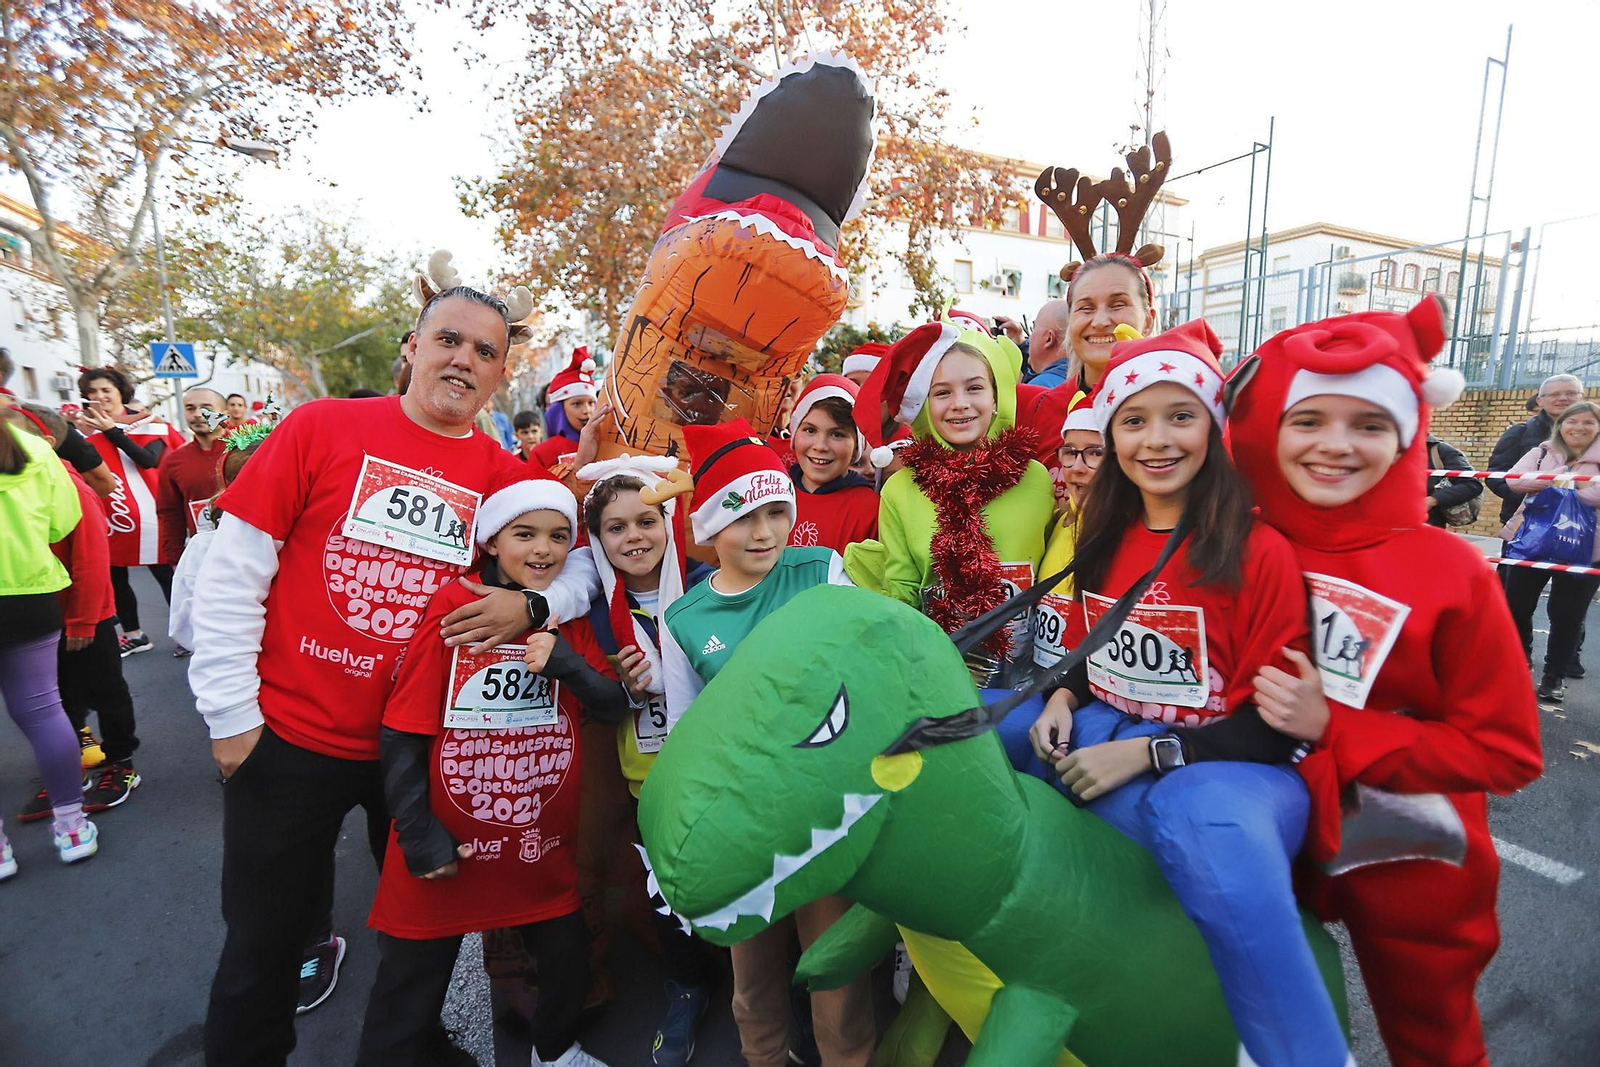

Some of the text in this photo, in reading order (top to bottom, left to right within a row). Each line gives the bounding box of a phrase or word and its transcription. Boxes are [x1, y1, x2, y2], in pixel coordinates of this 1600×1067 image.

[400, 470, 423, 482] CARRERA
[423, 478, 434, 486] SAN
[434, 482, 458, 494] SILVESTRE
[418, 482, 436, 492] HUELVA
[751, 474, 782, 488] Feliz
[386, 488, 446, 532] 581
[326, 536, 380, 558] SAN
[326, 553, 450, 594] DE HUEL
[329, 574, 431, 608] 30 DE DICIE
[348, 599, 423, 638] 202
[1322, 611, 1339, 654] 1
[300, 636, 375, 670] Huelva
[702, 644, 726, 654] adidas
[1108, 630, 1162, 671] 580
[345, 667, 371, 678] original
[482, 668, 537, 701] 582
[649, 702, 667, 728] 5
[442, 736, 572, 757] SAN SILVESTRE
[443, 751, 571, 780] DE HUELVA
[450, 778, 482, 794] 30
[483, 781, 502, 793] DE
[472, 793, 541, 823] 2023
